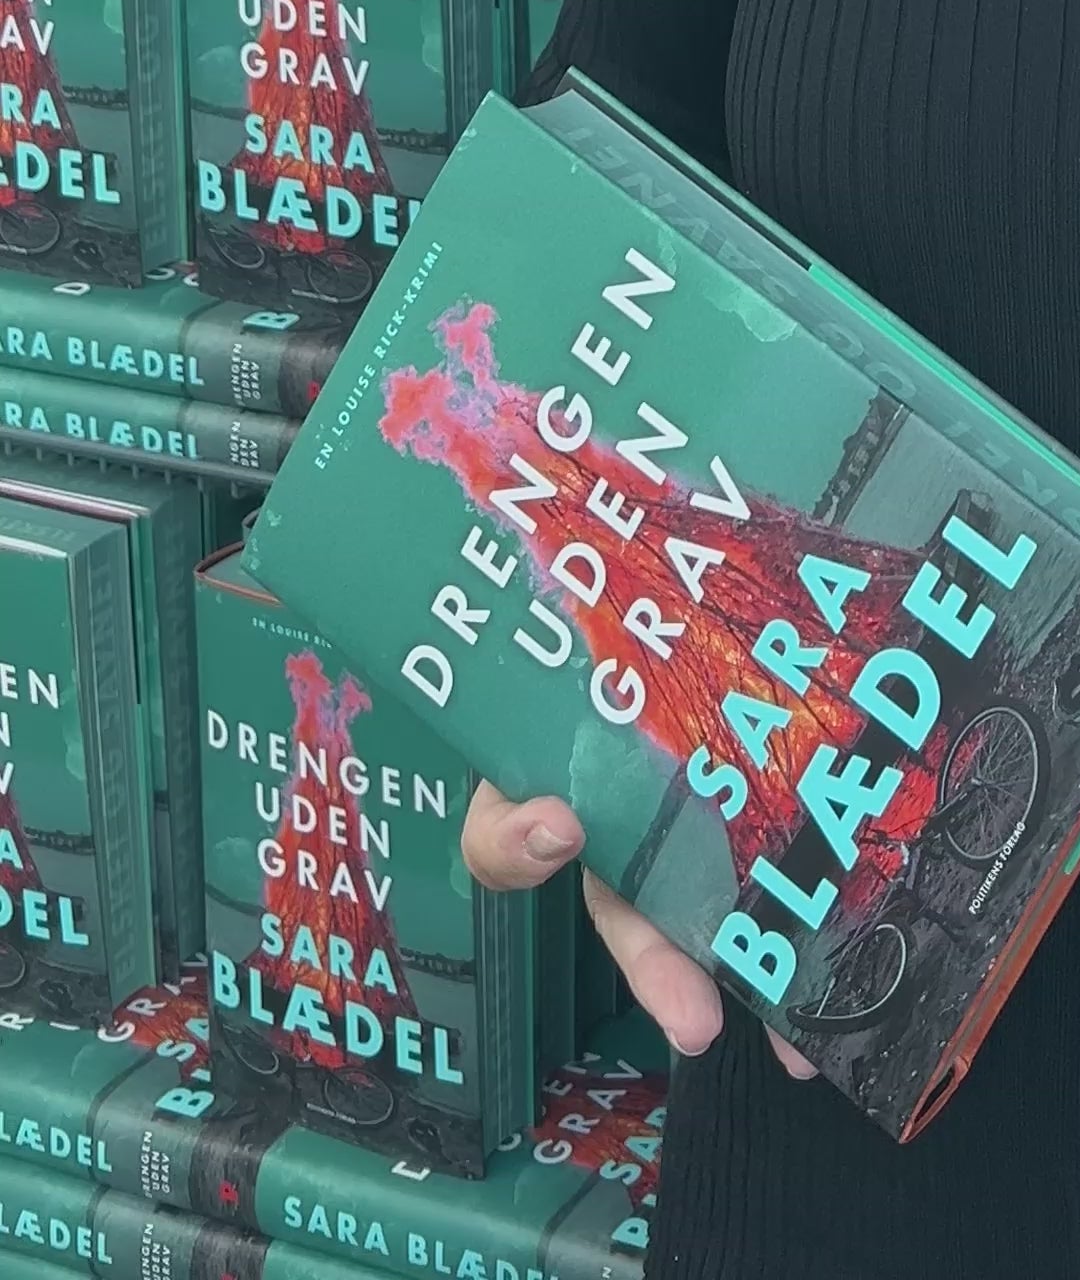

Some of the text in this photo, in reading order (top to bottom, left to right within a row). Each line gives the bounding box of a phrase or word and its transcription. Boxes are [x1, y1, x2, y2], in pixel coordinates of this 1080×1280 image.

[240, 43, 369, 96] GRAV
[244, 113, 375, 173] SARA
[67, 337, 205, 386] BLÆDEL
[315, 242, 443, 469] EN LOUISE RICK-KRIMI
[401, 247, 678, 707] DRENGEN
[513, 401, 690, 668] UDEN
[588, 457, 754, 726] GRAV
[685, 551, 870, 821] SARA
[208, 709, 448, 819] DRENGEN
[711, 513, 1039, 1003] BLÆDEL
[255, 782, 391, 858] UDEN
[257, 841, 393, 912] GRAV
[969, 860, 1003, 914] POLITIKENS
[261, 913, 397, 997] SARA
[212, 950, 464, 1085] BLÆDEL
[284, 1196, 388, 1255] SARA
